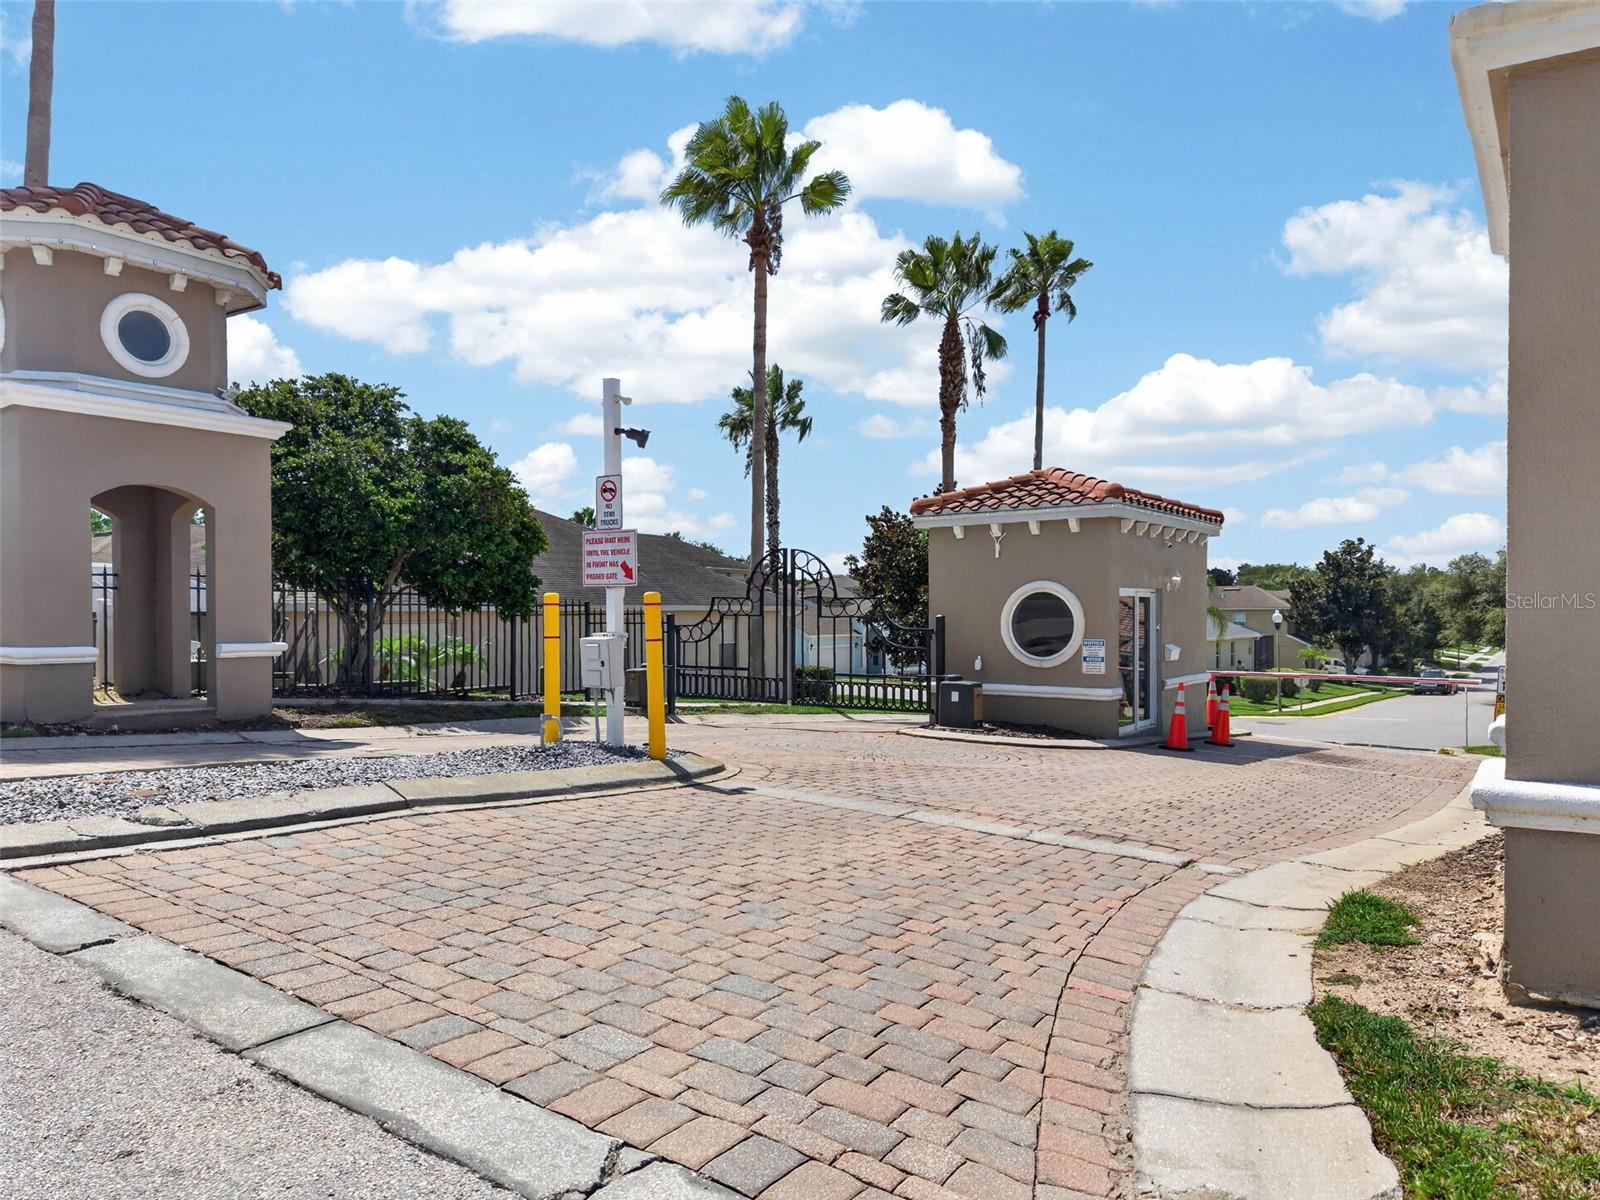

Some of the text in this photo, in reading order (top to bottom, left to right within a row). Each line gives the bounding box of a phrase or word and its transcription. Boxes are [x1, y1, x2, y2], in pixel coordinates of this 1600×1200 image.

[586, 537, 603, 545] PLEASE
[610, 548, 630, 556] VEHICLE
[608, 560, 619, 568] HAS
